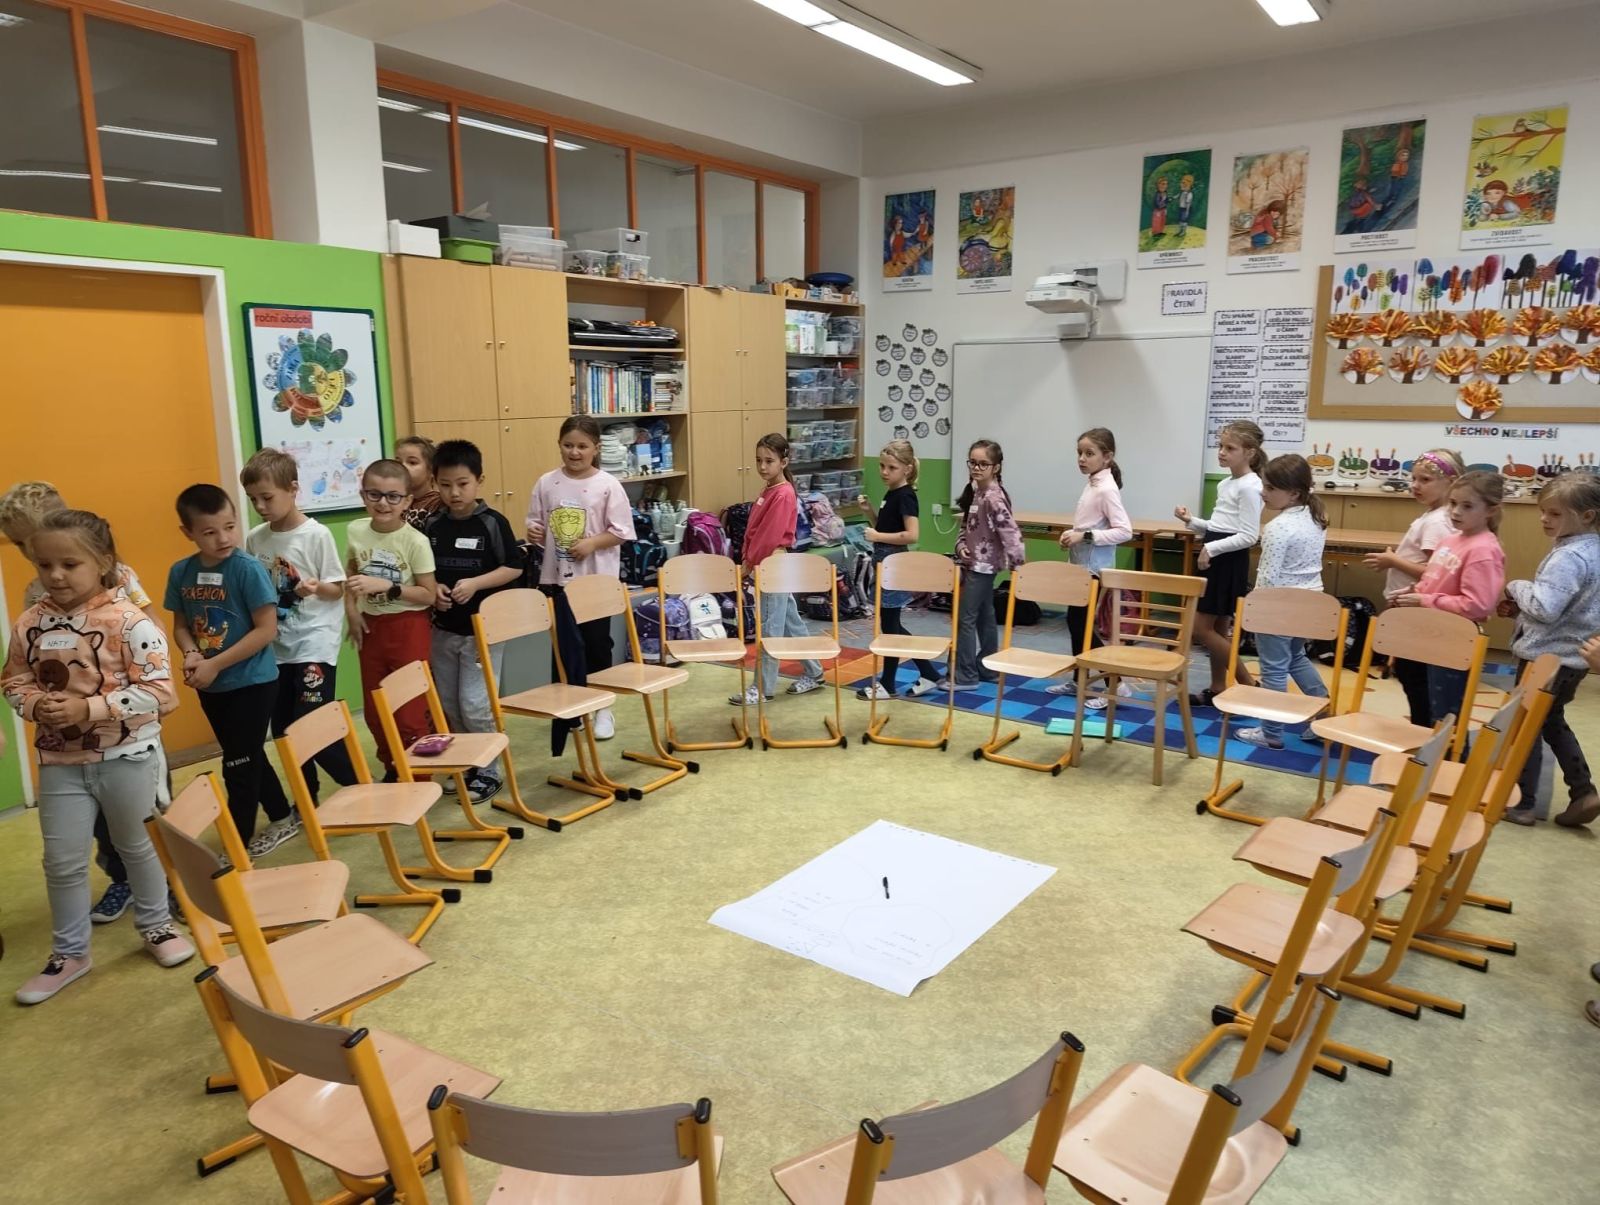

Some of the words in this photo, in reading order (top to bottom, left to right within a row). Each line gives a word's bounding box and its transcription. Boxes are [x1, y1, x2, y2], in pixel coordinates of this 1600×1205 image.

[1167, 288, 1203, 297] PRAVIDLA
[1173, 299, 1196, 308] ČTENÍ
[1445, 425, 1499, 436] VŠECHNO
[1502, 427, 1559, 438] NEJLEPŠÍ
